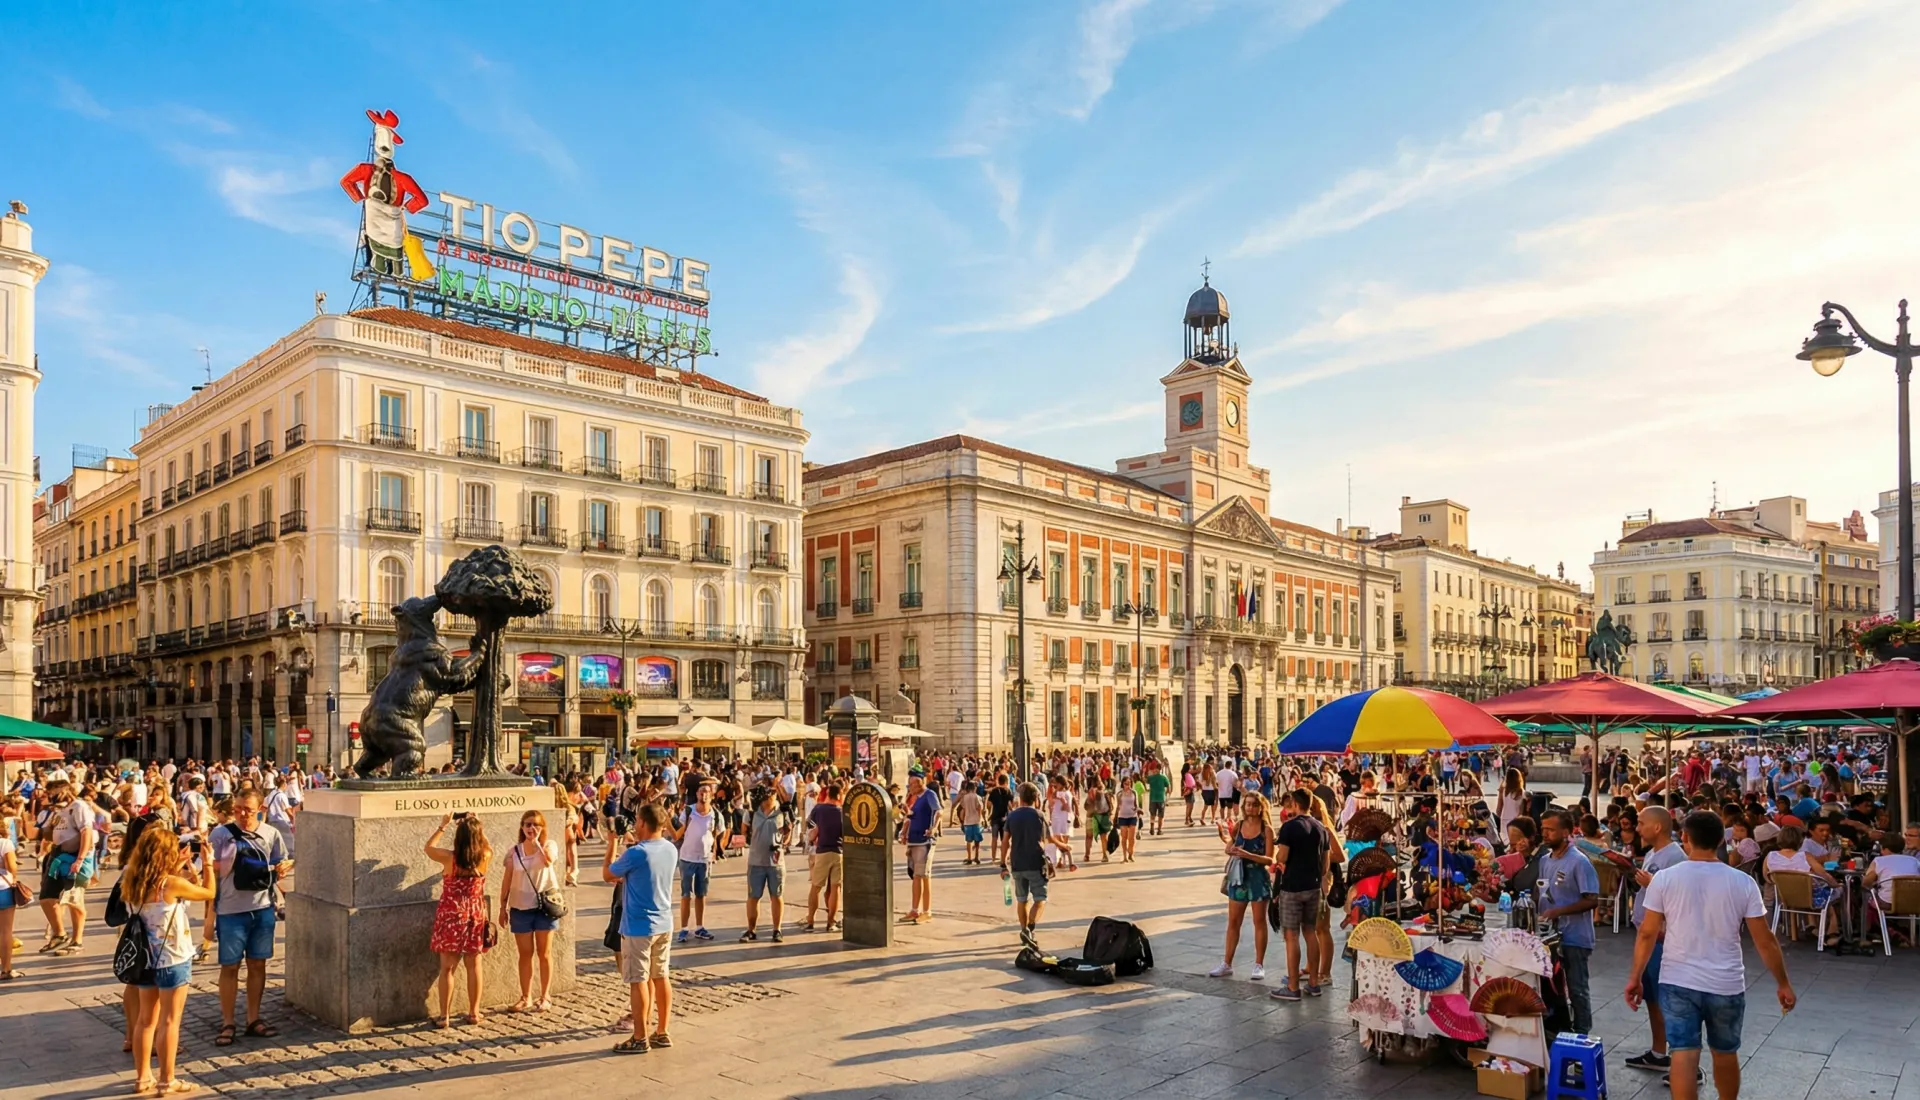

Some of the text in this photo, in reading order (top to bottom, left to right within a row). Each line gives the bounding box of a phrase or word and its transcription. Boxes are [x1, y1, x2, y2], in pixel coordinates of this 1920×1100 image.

[439, 191, 539, 255] TIO
[560, 223, 711, 300] PEPE
[395, 799, 411, 811] EL
[413, 799, 440, 810] OSO
[452, 799, 464, 809] EL
[465, 794, 526, 808] MADROÑO
